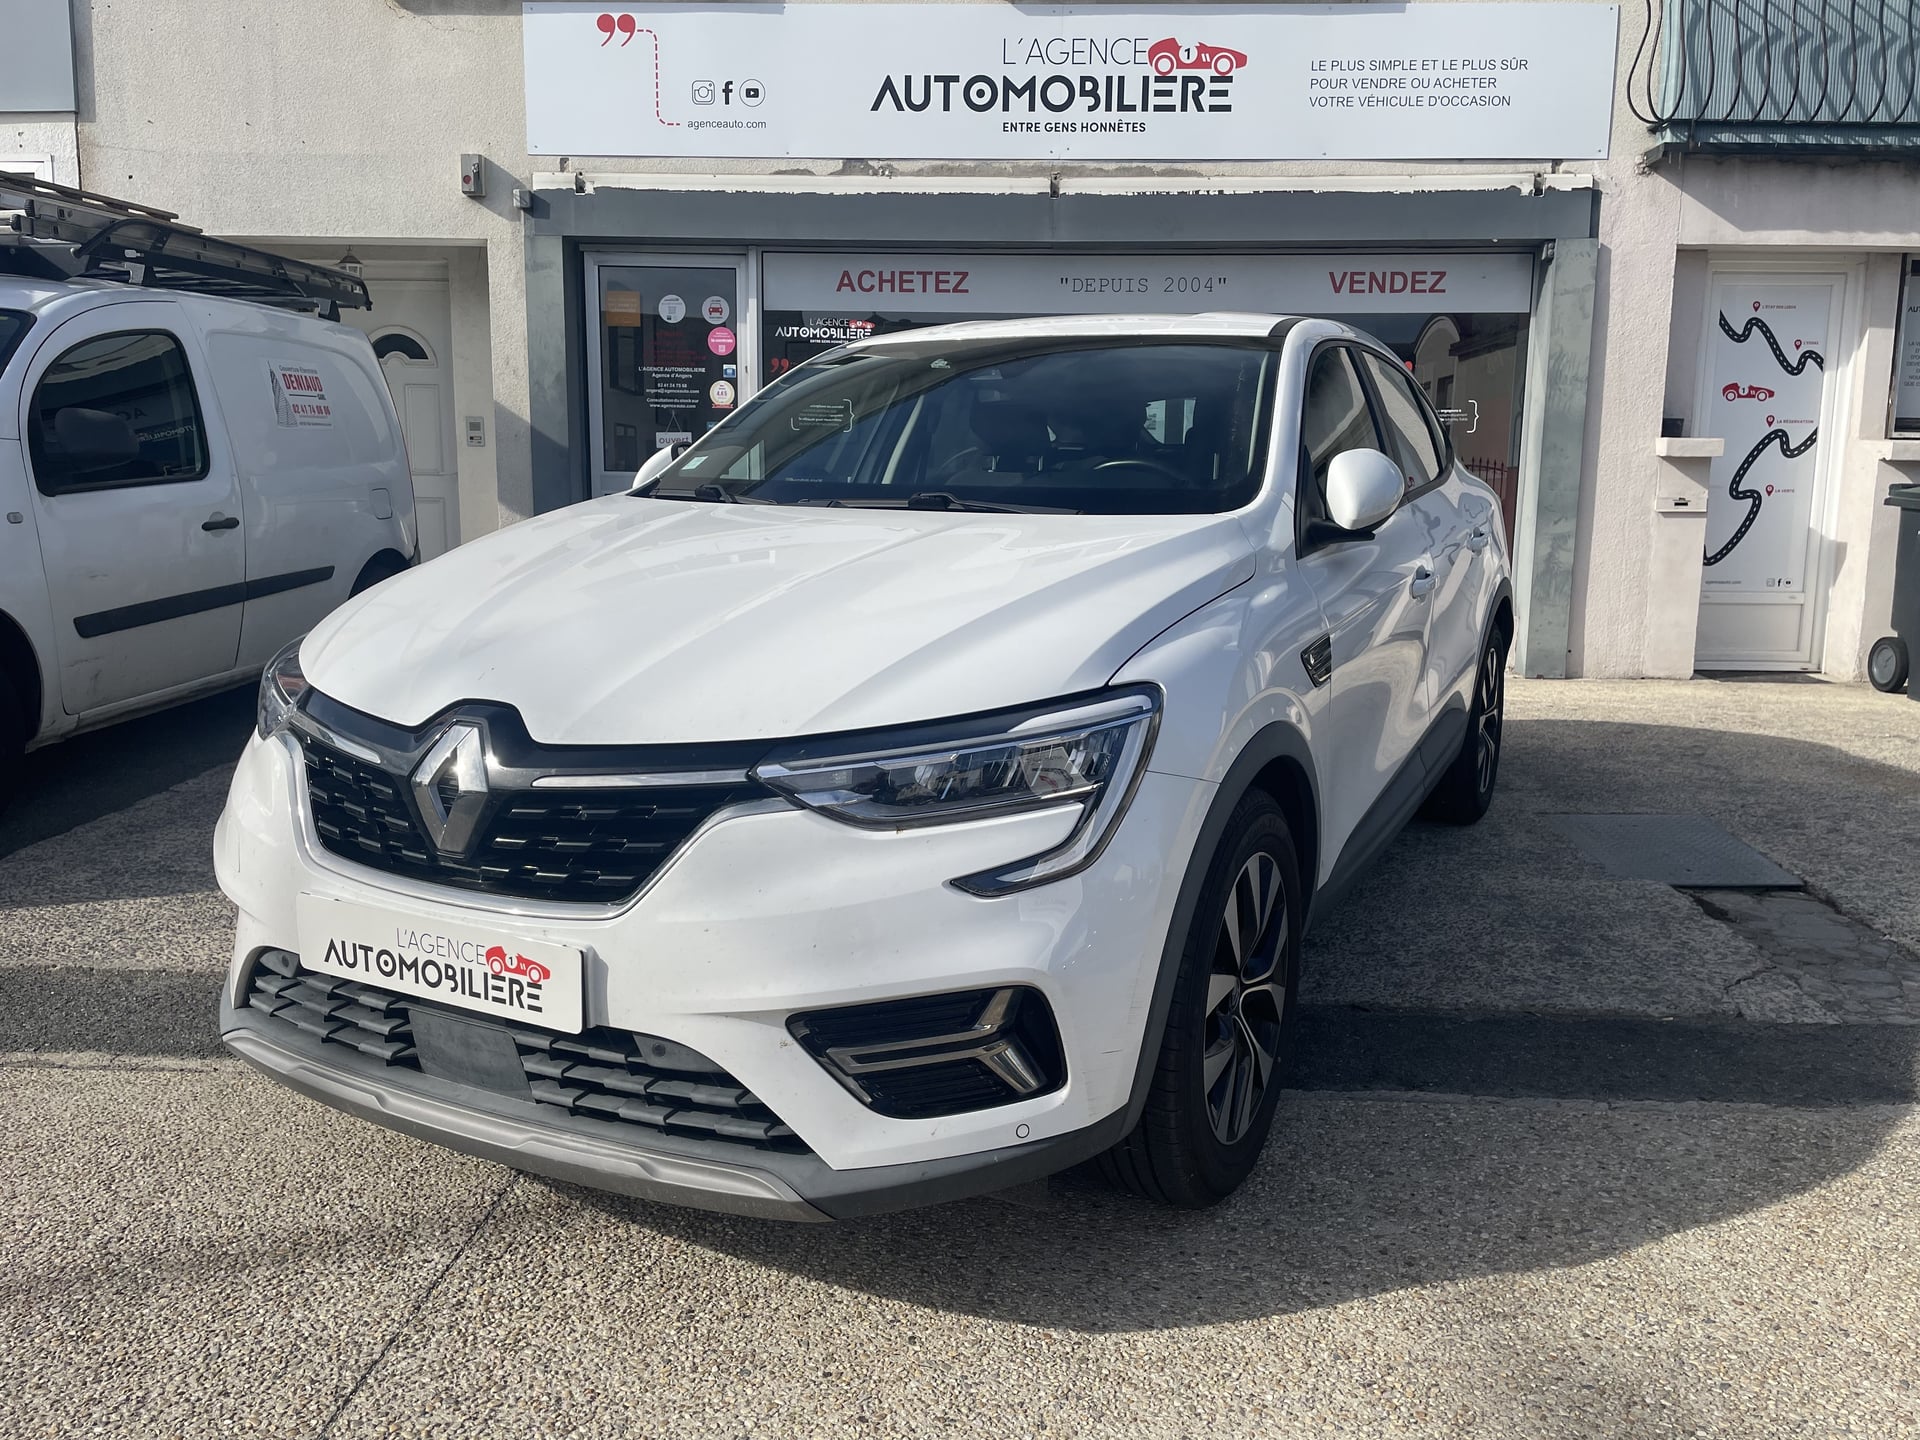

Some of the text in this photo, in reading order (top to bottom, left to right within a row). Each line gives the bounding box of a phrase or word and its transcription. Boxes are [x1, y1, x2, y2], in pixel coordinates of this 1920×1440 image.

[1003, 38, 1150, 66] L'AGENCE
[1311, 56, 1528, 71] LE PLUS SIMPLE ET LE PLUS SÛR
[1310, 77, 1497, 89] POUR VENDRE OU ACHETER
[1309, 93, 1511, 107] VOTRE VÉHICULE D'OCCASION
[687, 119, 767, 131] agenceauto.com
[1003, 119, 1146, 132] ENTRE GENS HONNÊTES
[835, 270, 969, 294] ACHETEZ
[1060, 276, 1228, 293] "DEPUIS 2004"
[1328, 271, 1447, 294] VENDEZ
[810, 318, 848, 326] L'AGENCE
[282, 373, 323, 392] DENIAUD
[397, 928, 487, 966] L'AGENCE
